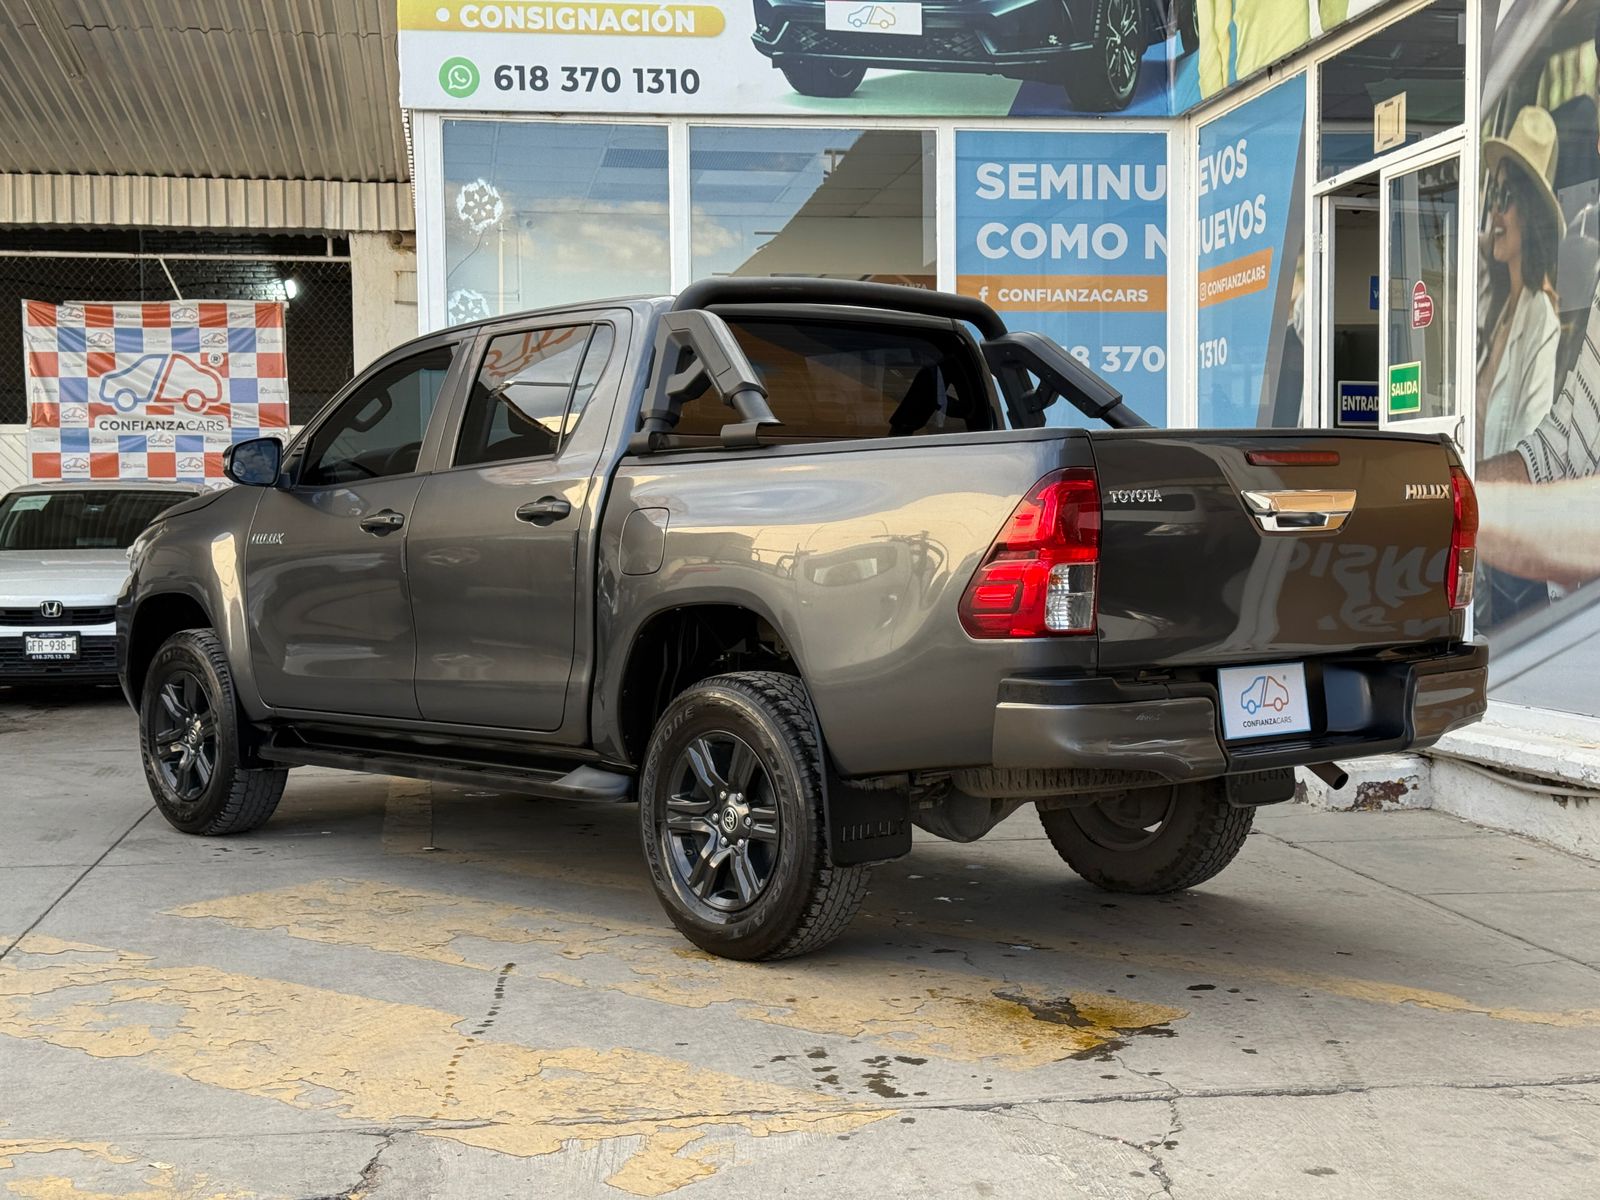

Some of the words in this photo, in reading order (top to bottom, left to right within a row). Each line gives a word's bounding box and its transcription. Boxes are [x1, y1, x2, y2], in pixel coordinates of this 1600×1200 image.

[459, 4, 695, 33] CONSIGNACIÓN
[494, 65, 549, 92] 618
[561, 66, 621, 93] 370
[632, 68, 700, 94] 1310
[975, 162, 1167, 201] SEMINU
[1198, 138, 1248, 197] EVOS
[1198, 193, 1267, 256] UEVOS
[976, 222, 1129, 260] COMO
[1207, 265, 1266, 296] CONFIANZACARS
[998, 288, 1149, 303] CONFIANZACARS
[1100, 345, 1166, 373] 370
[1200, 337, 1227, 369] 1310
[1391, 380, 1418, 397] SALIDA
[99, 420, 225, 431] CONFIANZACARS
[1109, 489, 1163, 503] TOYOTA
[1405, 484, 1450, 500] HILUX
[1242, 716, 1292, 728] CONFIANZACARS
